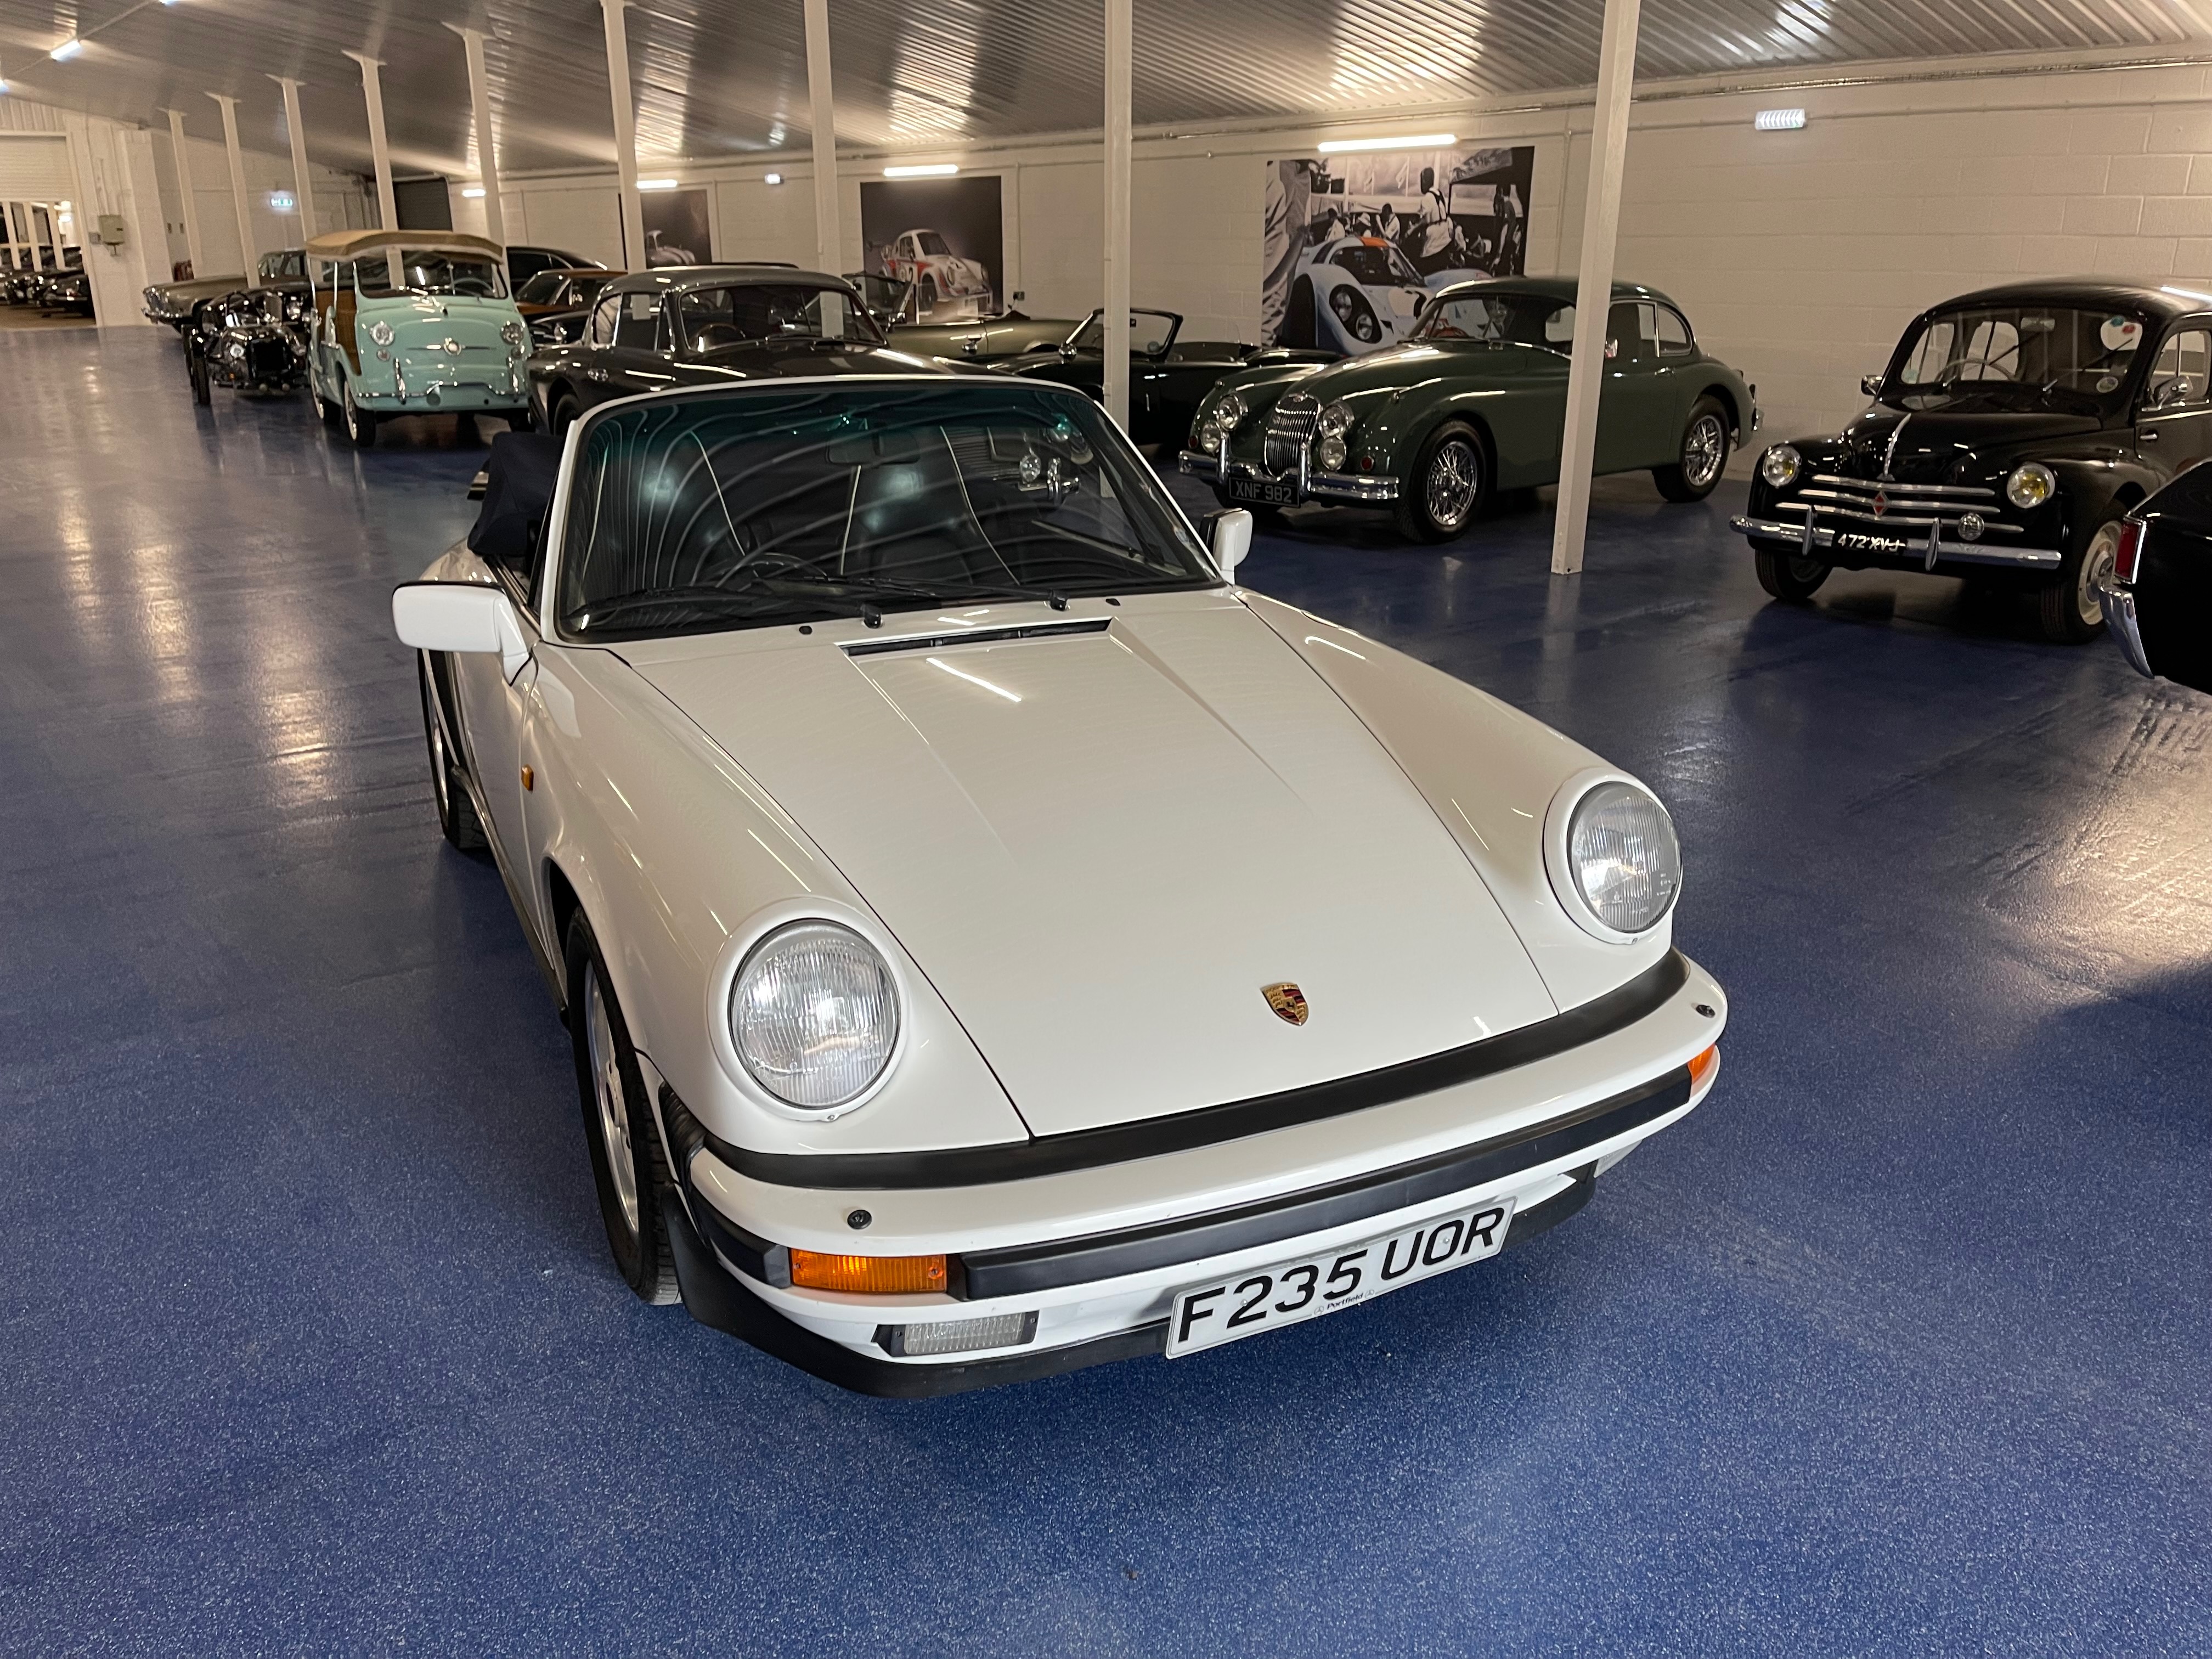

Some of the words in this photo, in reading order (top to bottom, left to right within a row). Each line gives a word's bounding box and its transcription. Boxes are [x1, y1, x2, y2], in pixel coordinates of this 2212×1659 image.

[1235, 481, 1261, 499] XNF
[1265, 485, 1292, 503] 982
[1837, 533, 1867, 549] 472
[1177, 1249, 1369, 1344] F235
[1380, 1207, 1504, 1280] UOR
